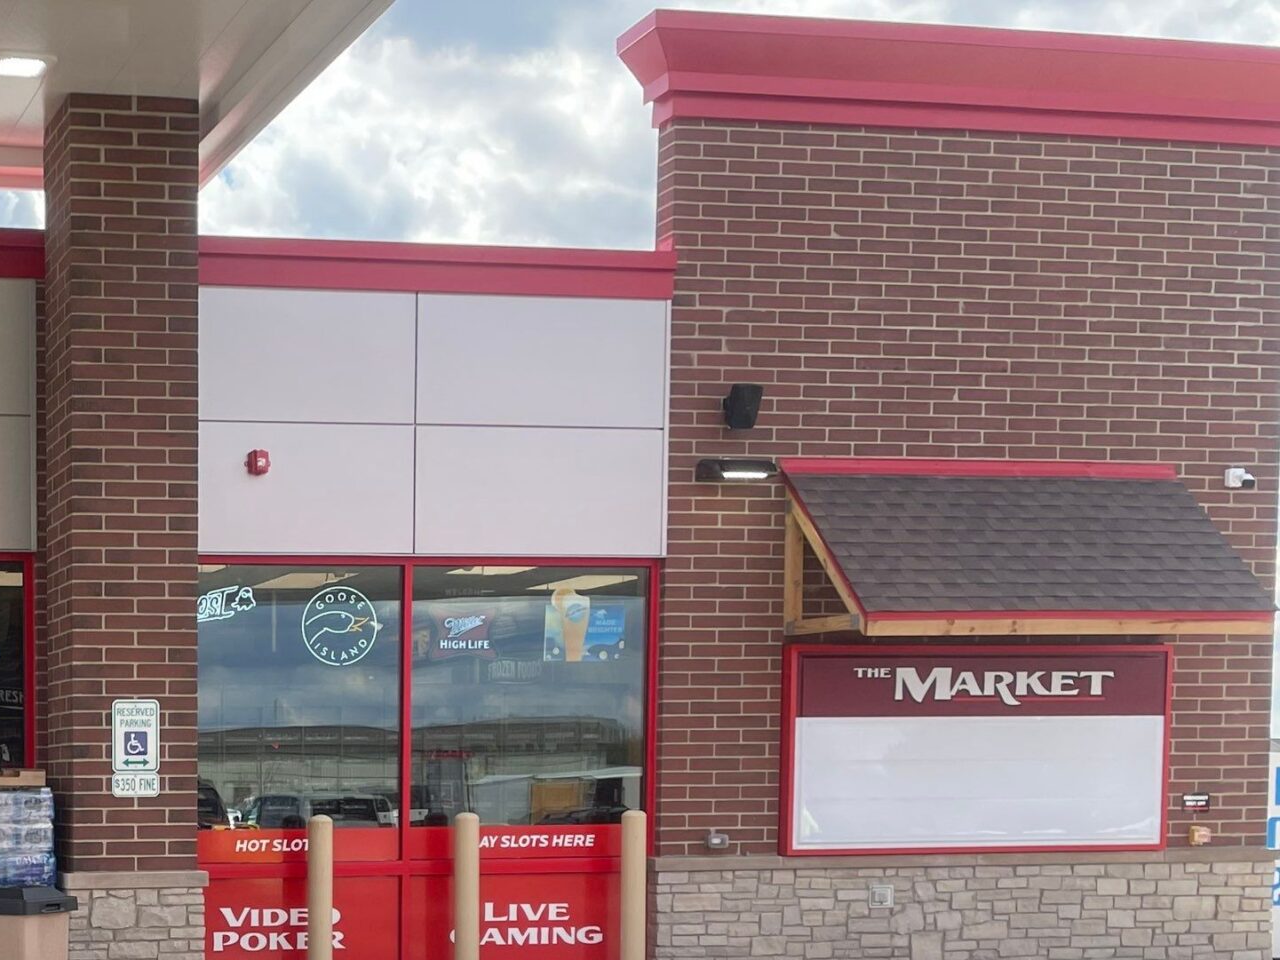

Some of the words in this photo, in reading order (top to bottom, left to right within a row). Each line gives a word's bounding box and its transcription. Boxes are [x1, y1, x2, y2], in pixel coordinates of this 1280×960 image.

[315, 592, 365, 610] GOOSE
[314, 639, 367, 661] ISLAND
[440, 640, 467, 649] HIGH
[468, 640, 490, 649] LIFE
[853, 667, 892, 678] THE
[894, 667, 1115, 706] MARKET
[116, 707, 155, 717] RESERVED
[120, 719, 152, 728] PARKING
[114, 778, 136, 792] $350
[139, 778, 156, 791] FINE
[235, 839, 271, 852] HOT
[271, 838, 309, 852] SLOT
[479, 836, 498, 848] AY
[500, 835, 549, 848] SLOTS
[551, 834, 596, 847] HERE
[219, 907, 342, 928] VIDE
[484, 902, 570, 922] LIVE
[449, 926, 604, 947] AMING
